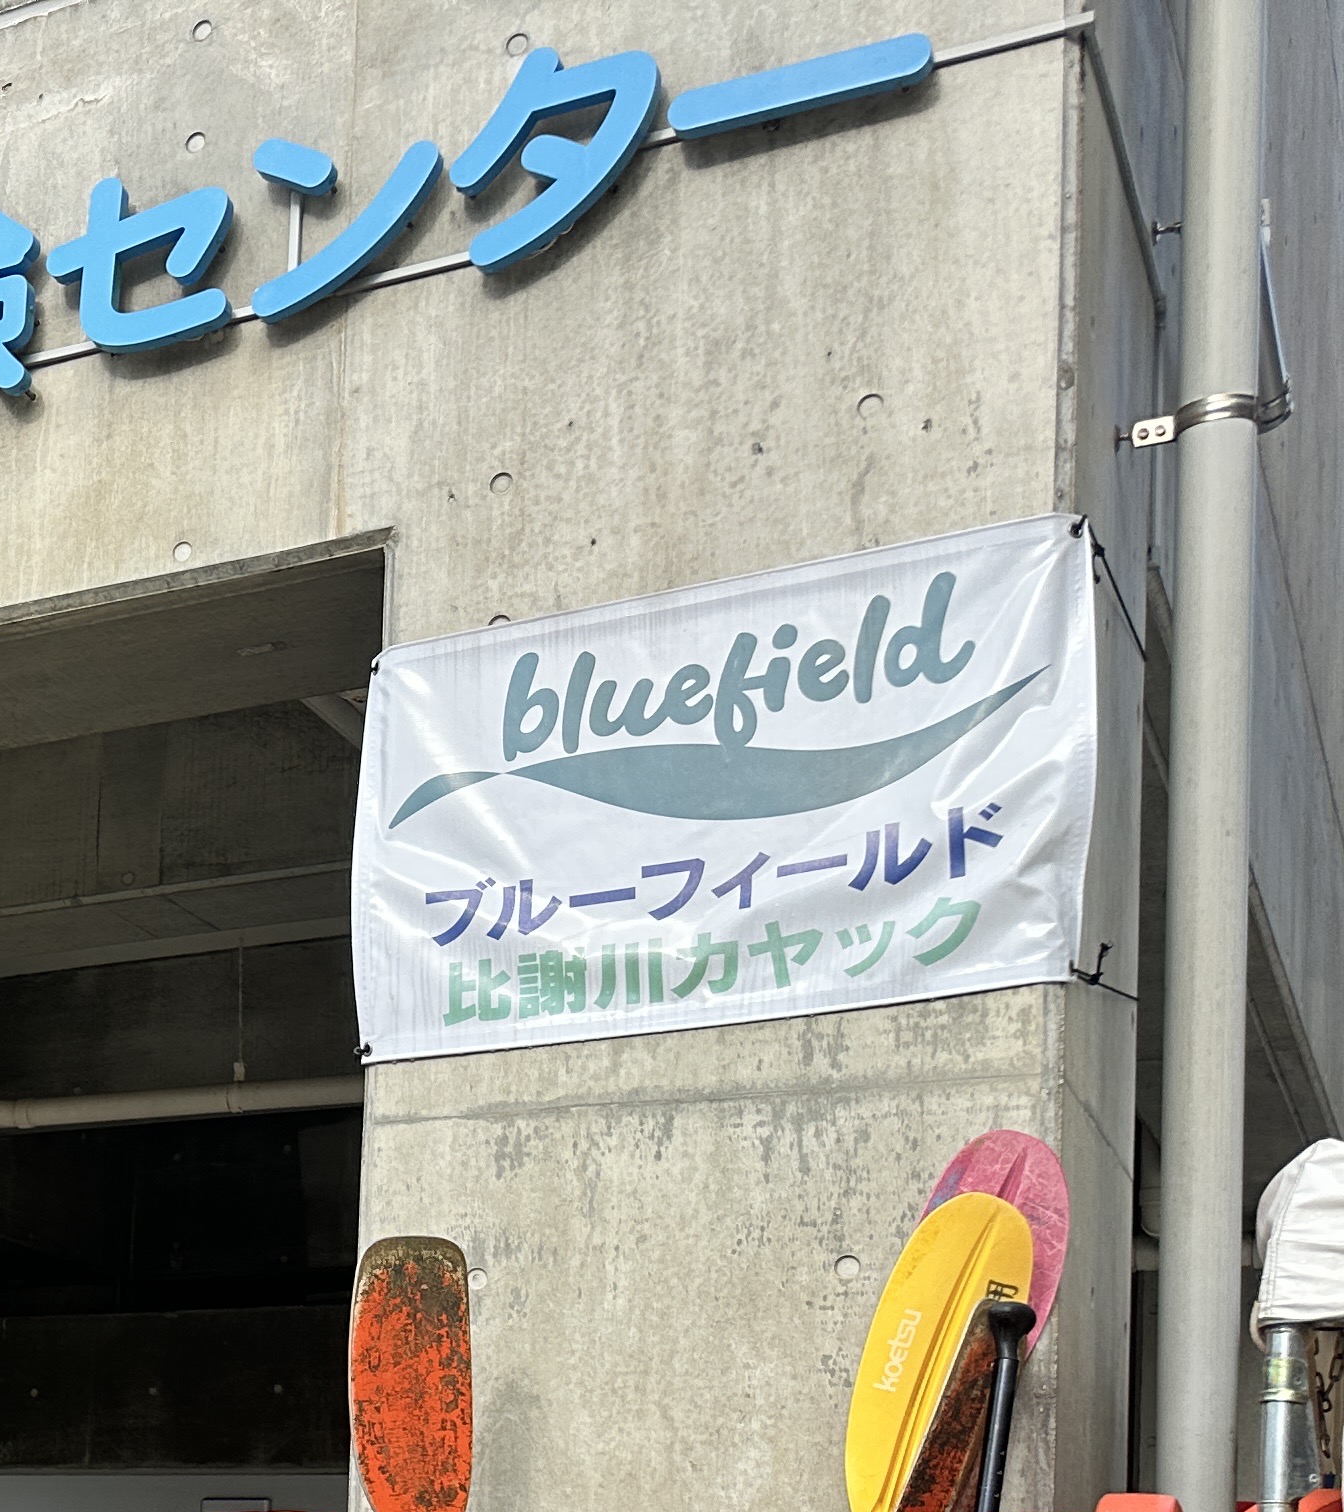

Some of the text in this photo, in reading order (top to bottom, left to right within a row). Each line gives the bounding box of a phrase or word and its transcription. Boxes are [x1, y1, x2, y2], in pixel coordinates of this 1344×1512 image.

[502, 571, 976, 762] bluefield
[423, 802, 1006, 948] ブルーフィールド
[442, 895, 983, 1028] 比謝川カヤック
[872, 1308, 922, 1392] koetsu
